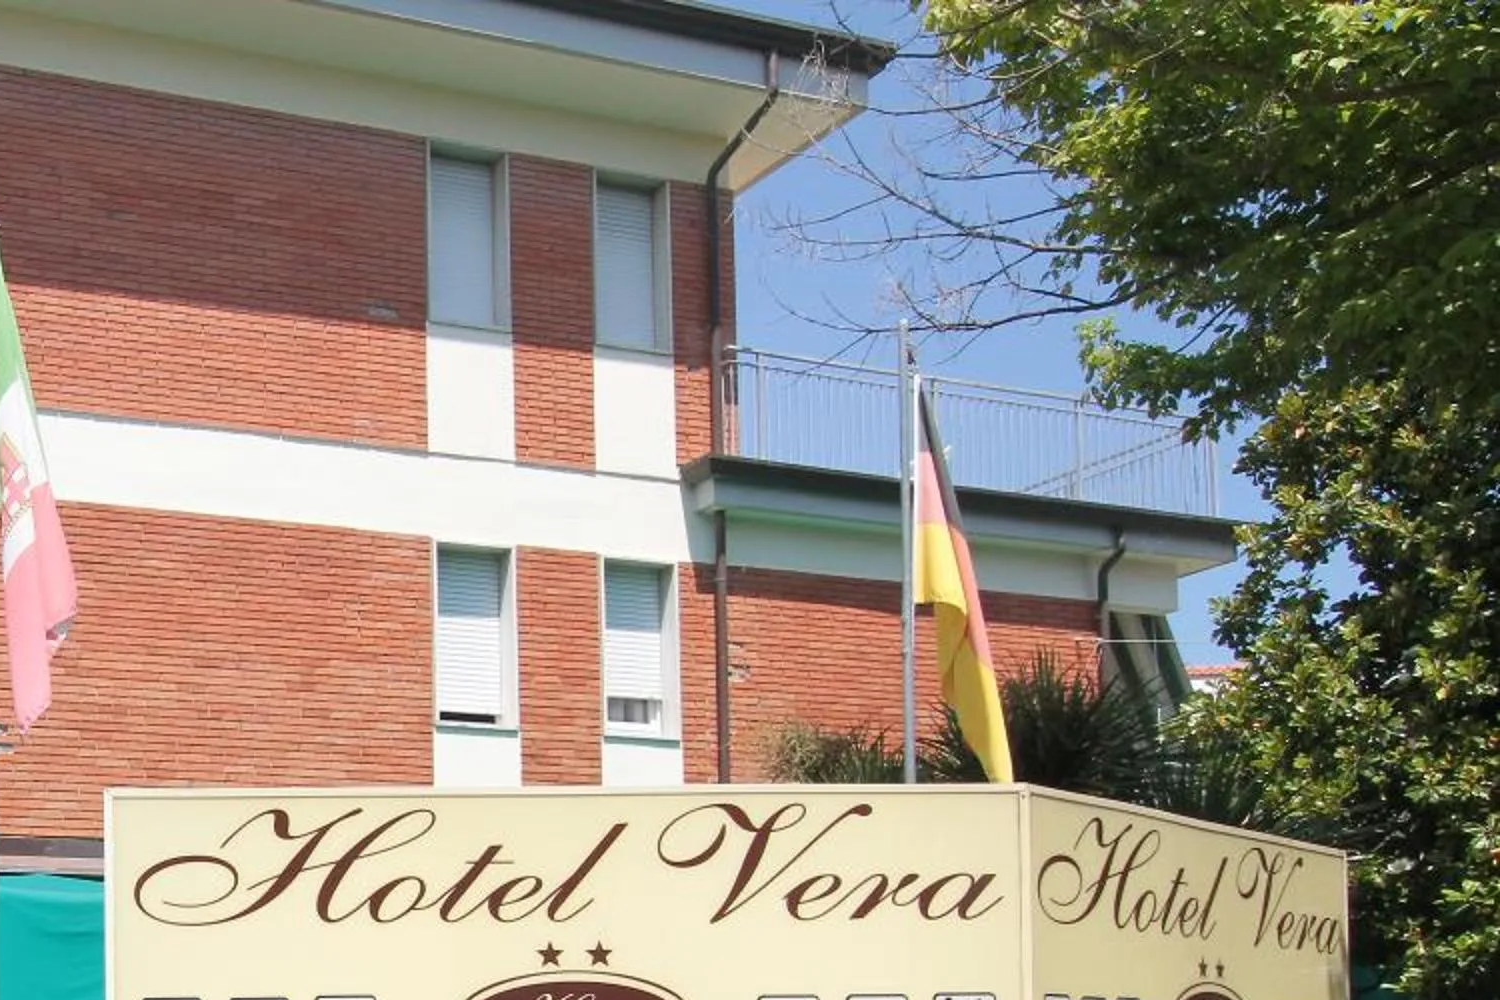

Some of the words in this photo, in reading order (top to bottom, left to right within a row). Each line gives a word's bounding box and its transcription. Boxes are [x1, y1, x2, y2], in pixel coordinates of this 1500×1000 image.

[134, 807, 628, 926] Hotel
[657, 803, 1004, 924] Vera
[1037, 816, 1228, 941] Hotel
[1236, 847, 1340, 954] Vera
